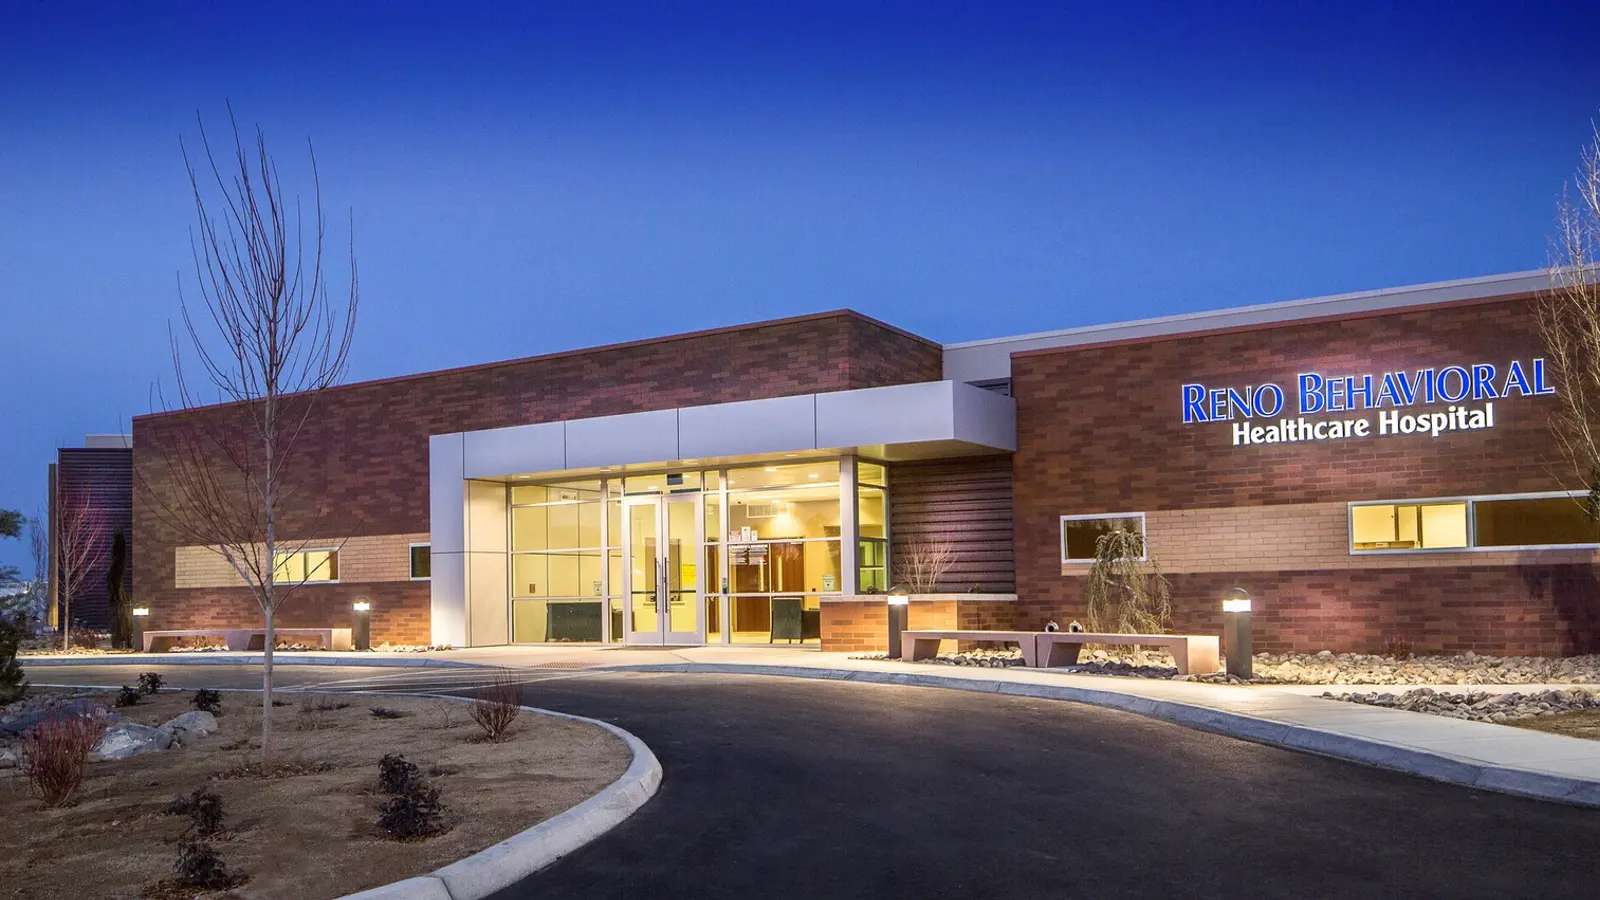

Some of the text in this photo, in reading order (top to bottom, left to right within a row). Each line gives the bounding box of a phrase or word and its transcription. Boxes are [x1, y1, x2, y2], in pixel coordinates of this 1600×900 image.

[1182, 357, 1555, 424] RENO BEHAVIORAL
[1232, 402, 1494, 446] Healthcare Hospital
